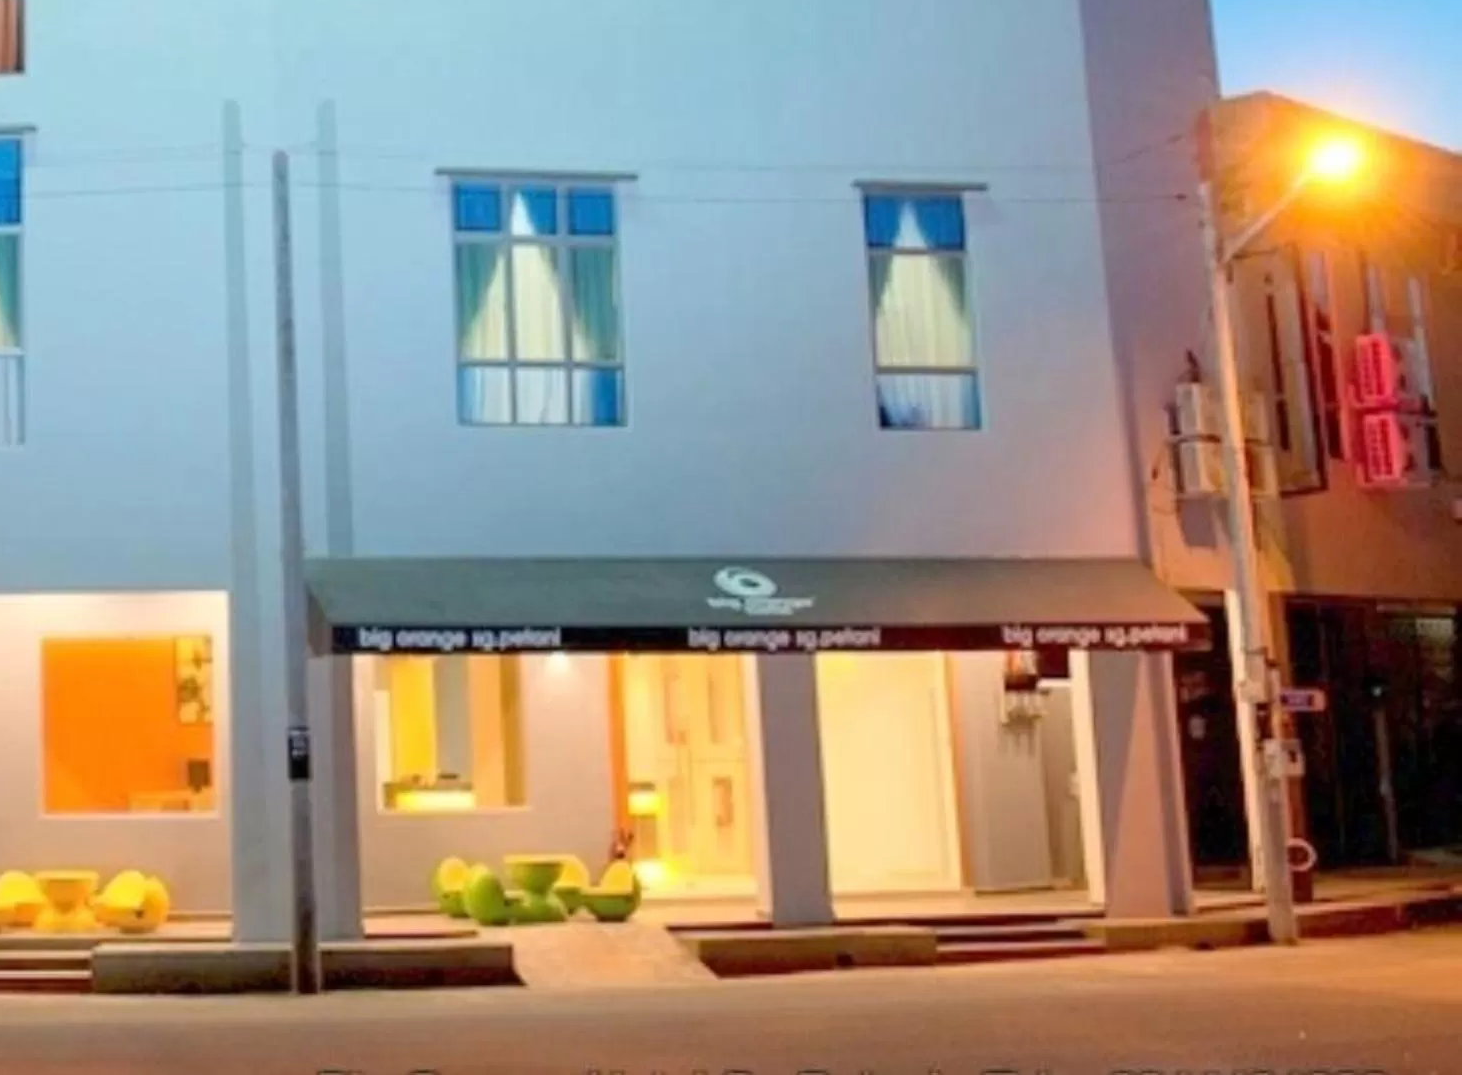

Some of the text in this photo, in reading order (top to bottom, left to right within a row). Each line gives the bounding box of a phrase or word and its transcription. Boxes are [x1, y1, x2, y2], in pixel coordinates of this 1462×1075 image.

[359, 626, 393, 652] big
[396, 629, 467, 652] orange
[688, 626, 721, 652] big
[724, 629, 791, 652] orange
[1001, 623, 1033, 648] big
[1036, 627, 1101, 648] orange
